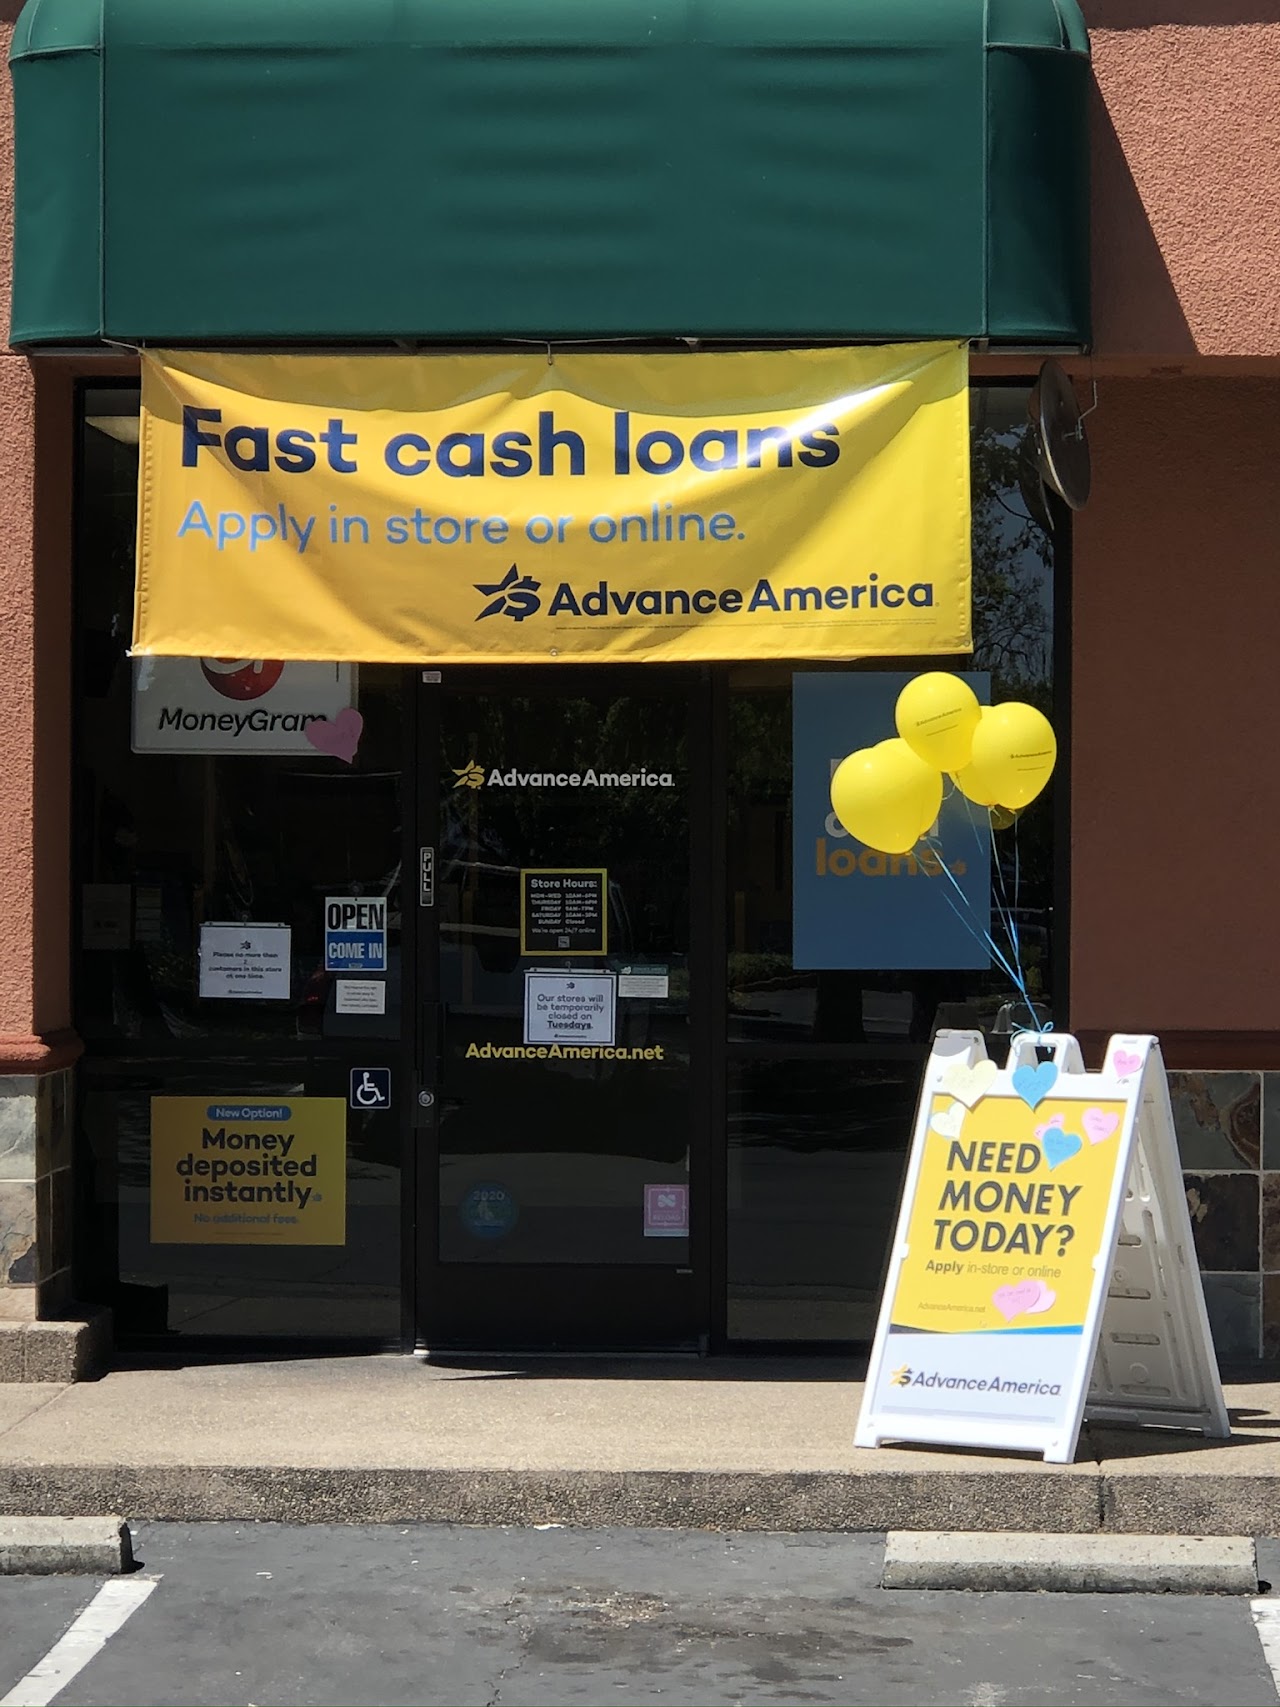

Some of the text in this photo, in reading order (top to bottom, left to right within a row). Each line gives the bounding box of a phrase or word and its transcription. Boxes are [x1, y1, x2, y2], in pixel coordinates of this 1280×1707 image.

[182, 404, 841, 477] Fast cash loans
[177, 501, 746, 553] Apply in store or online.
[816, 837, 943, 877] loans
[422, 852, 432, 892] PULL
[531, 879, 598, 888] Store Hours:
[327, 903, 384, 930] OPEN
[329, 942, 382, 959] COME IN
[536, 1003, 604, 1013] be temporarily
[537, 994, 603, 1003] Our stores will
[547, 1021, 593, 1030] Tuesdays.
[548, 1012, 578, 1020] closed
[465, 1042, 664, 1060] AdvanceAmerica.net
[216, 1108, 283, 1120] New Option!
[202, 1128, 295, 1156] Money
[176, 1153, 317, 1182] deposited
[946, 1141, 1042, 1174] NEED
[184, 1178, 312, 1209] instantly
[473, 1190, 505, 1200] 2020
[938, 1180, 1083, 1216] MONEY
[194, 1213, 209, 1223] No
[213, 1213, 270, 1224] additional
[933, 1219, 1076, 1257] TODAY?
[925, 1259, 1062, 1279] Apply in-store or online
[917, 1302, 986, 1314] AdvanceAmerica.net
